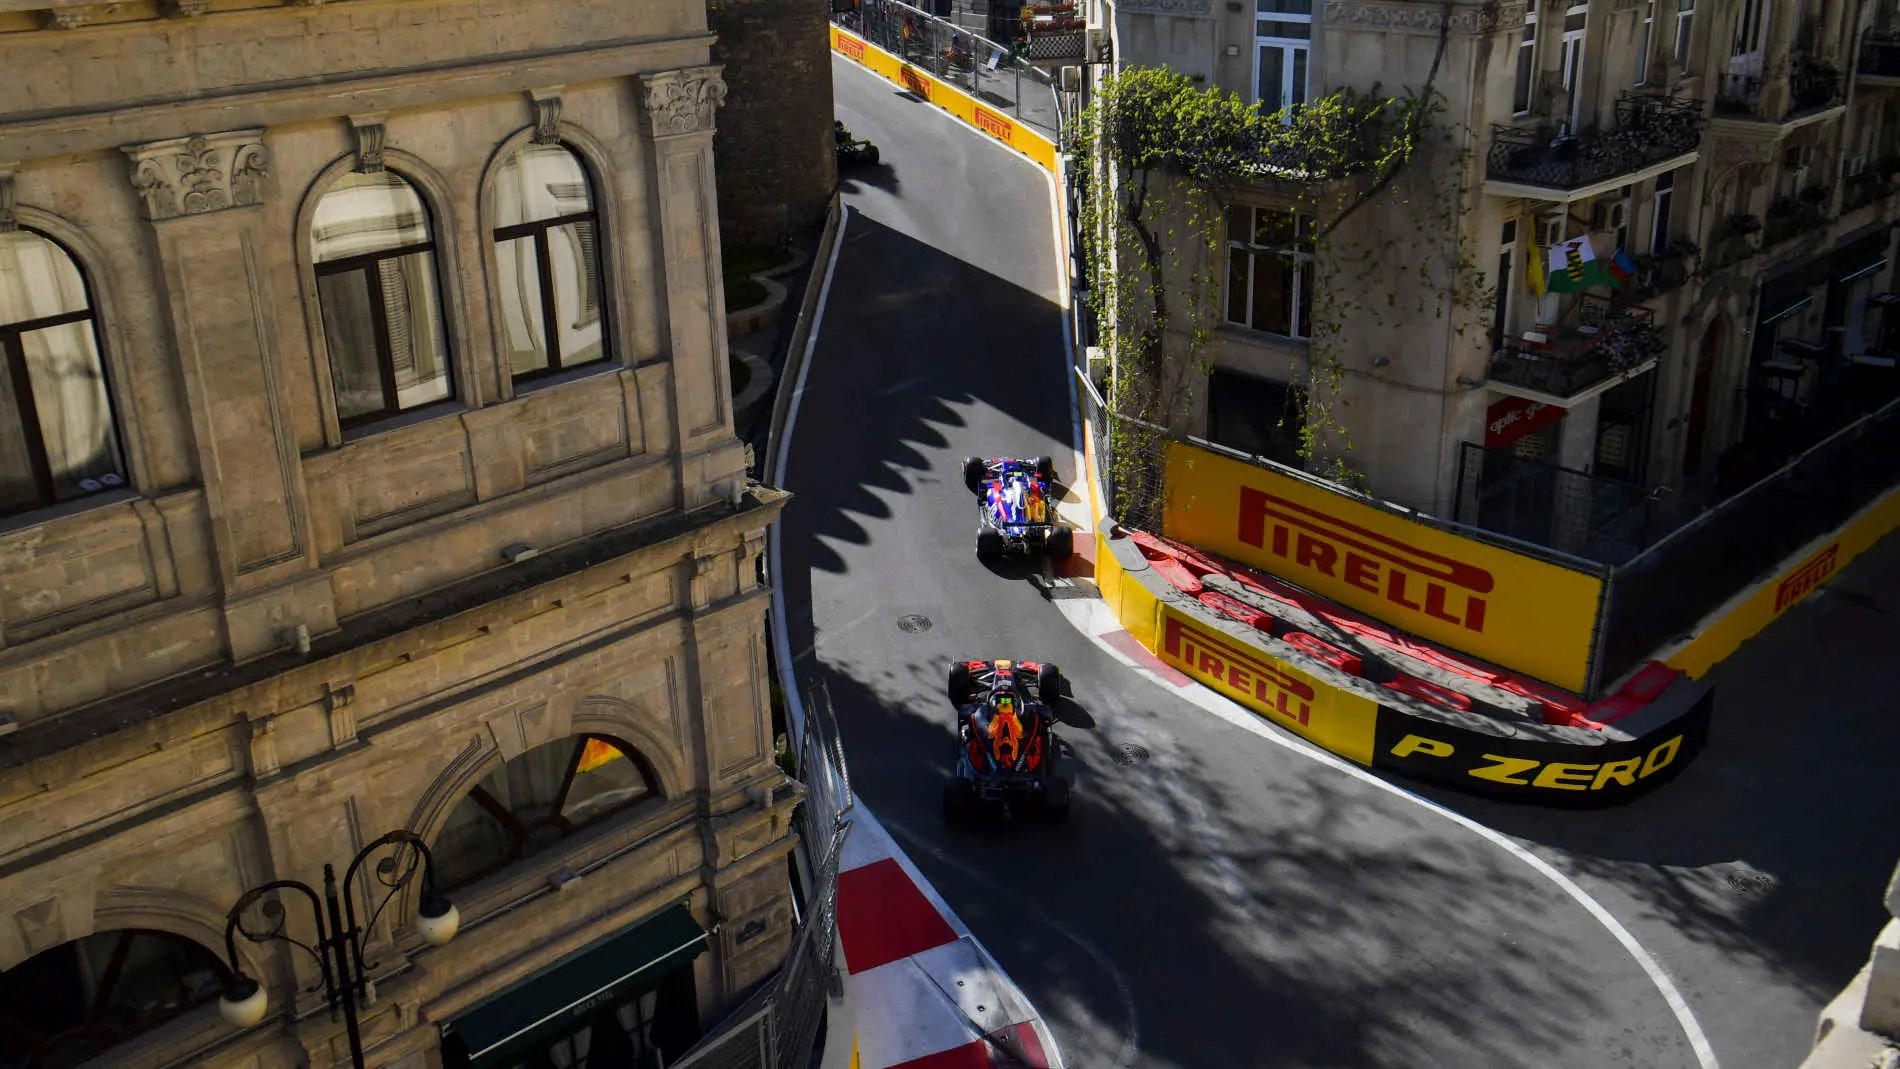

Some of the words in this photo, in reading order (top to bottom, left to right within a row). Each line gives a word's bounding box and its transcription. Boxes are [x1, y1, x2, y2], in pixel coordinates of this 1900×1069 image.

[838, 35, 866, 61] PIRELLI
[976, 107, 1011, 141] PIRELLI
[1239, 486, 1494, 632] PIRELLI
[1774, 543, 1839, 613] PIRELLI
[1165, 618, 1314, 727] PIRELLI
[1391, 734, 1454, 758] P
[1469, 735, 1683, 790] ZERO
